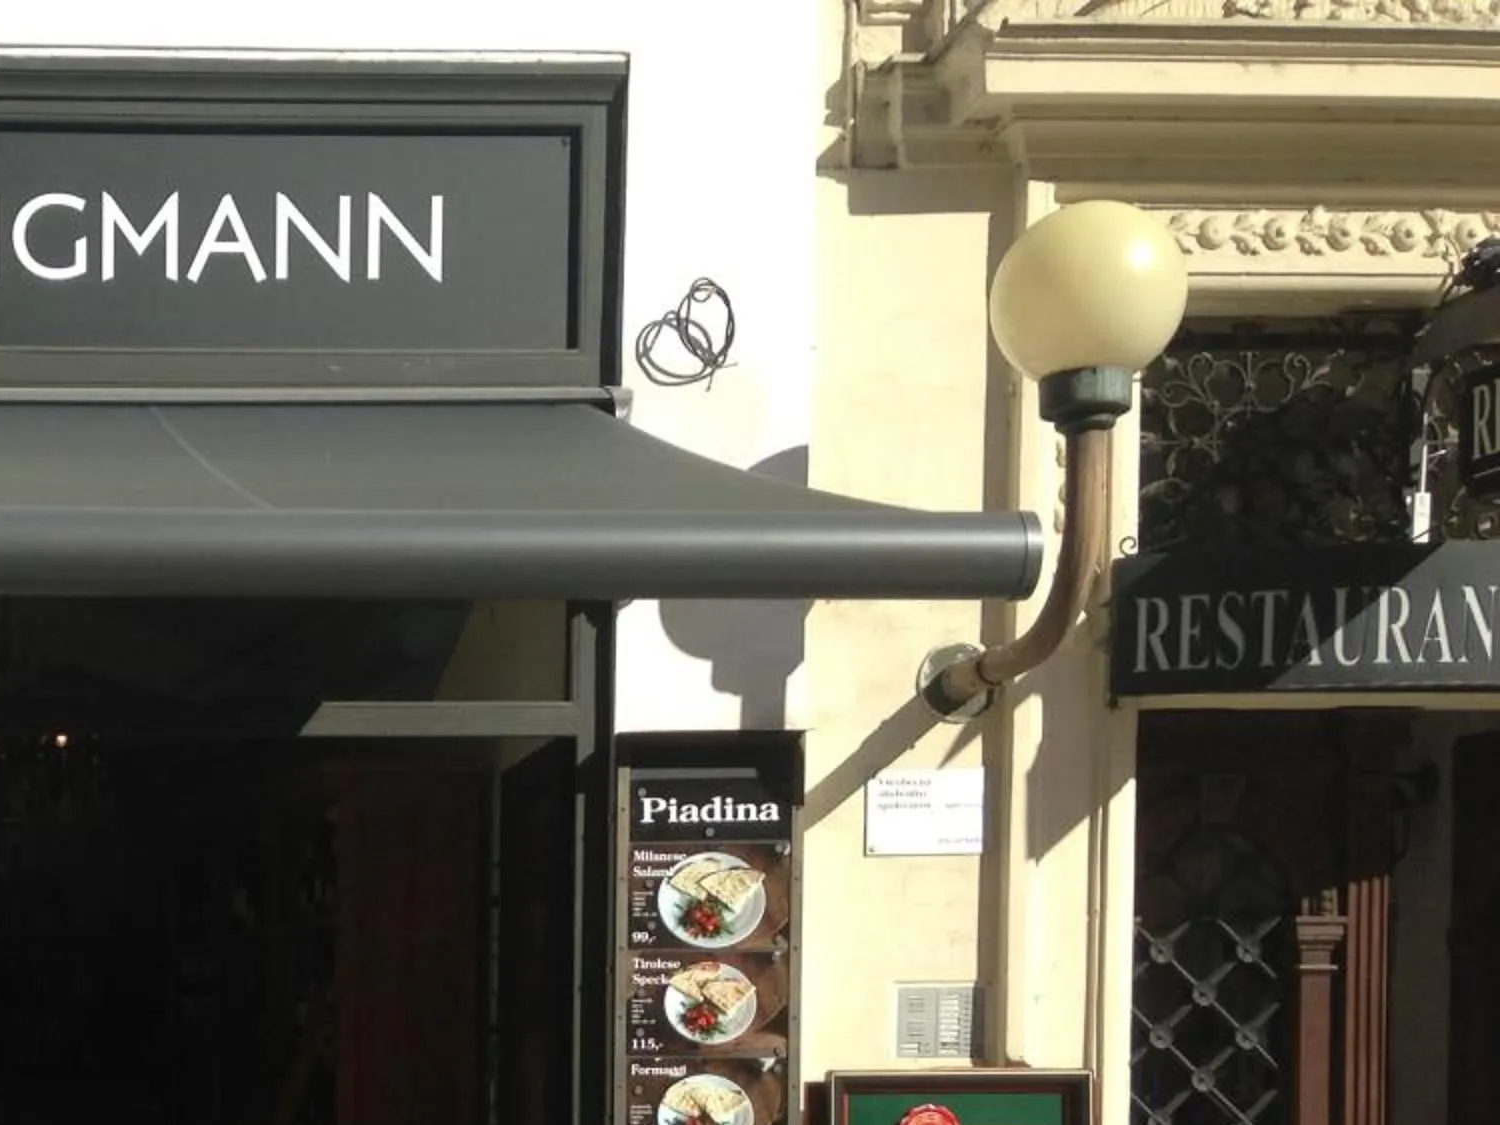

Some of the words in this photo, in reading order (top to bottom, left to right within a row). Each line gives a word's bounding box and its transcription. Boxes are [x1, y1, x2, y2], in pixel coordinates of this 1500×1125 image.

[1132, 585, 1500, 674] RESTAURAN
[639, 796, 781, 824] Piadina
[632, 850, 687, 862] Milanese
[631, 957, 681, 970] Tirolese
[631, 1038, 665, 1052] 115,-
[631, 1063, 687, 1078] Formaggi
